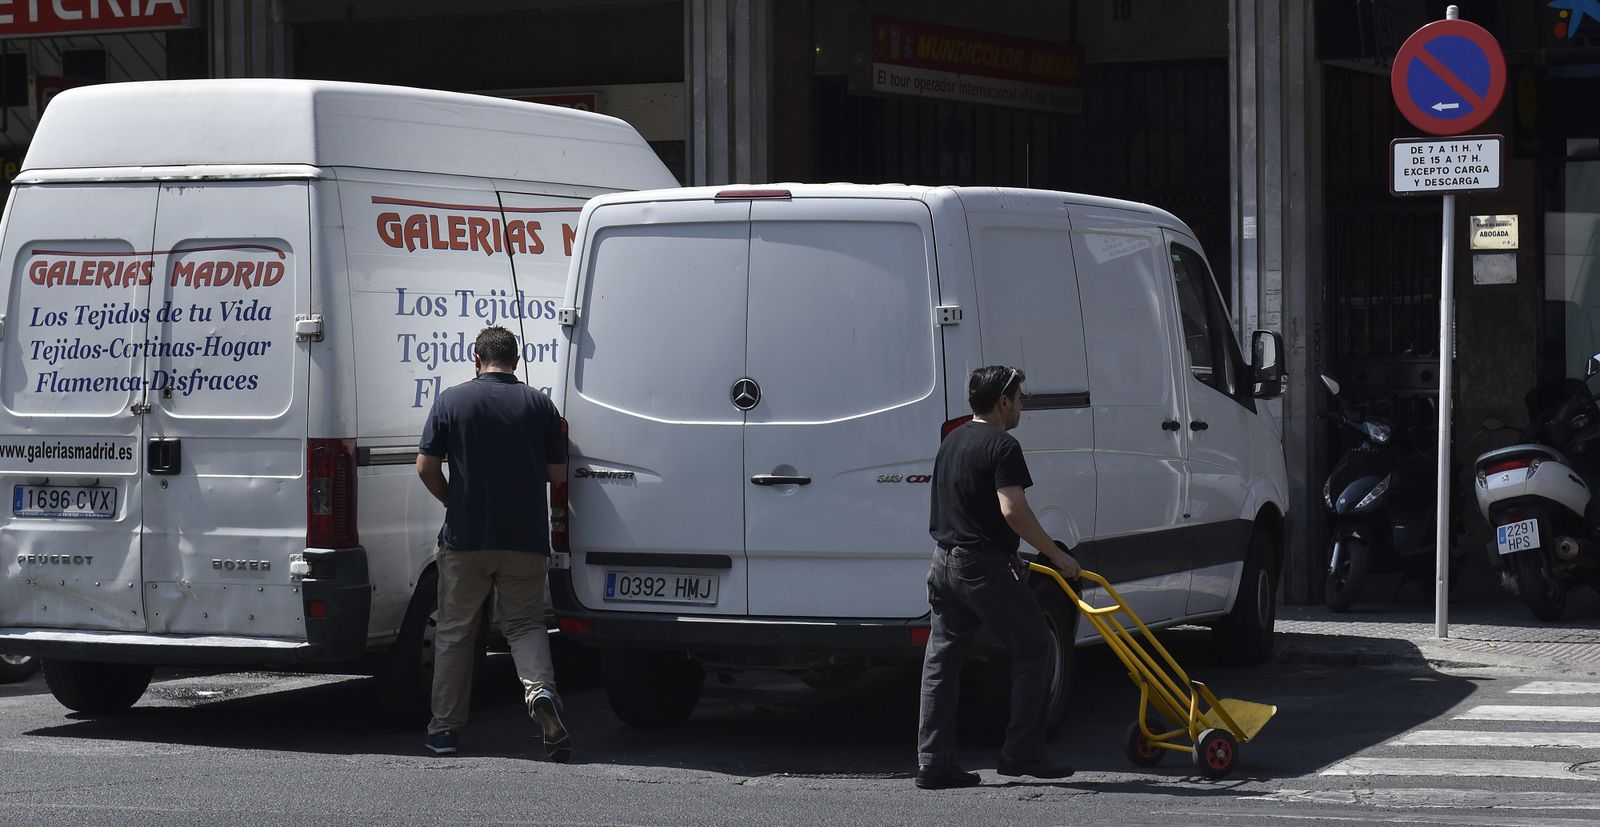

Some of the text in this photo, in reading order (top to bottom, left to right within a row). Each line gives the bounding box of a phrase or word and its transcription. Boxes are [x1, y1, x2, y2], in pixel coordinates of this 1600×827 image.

[1112, 0, 1132, 21] 10
[916, 33, 1025, 70] MUNDICOLOR
[877, 70, 887, 85] El
[890, 73, 911, 88] tour
[914, 77, 957, 95] operador
[960, 79, 1017, 102] internacional
[1410, 146, 1423, 154] DE
[1439, 145, 1446, 153] A
[1450, 145, 1458, 153] 11
[1462, 144, 1472, 152] H.
[1476, 143, 1483, 151] Y
[1412, 157, 1425, 165] DE
[1430, 156, 1440, 164] 15
[1457, 155, 1467, 163] 17
[1471, 154, 1482, 162] H.
[1404, 165, 1490, 176] EXCEPTO CARGA
[1414, 176, 1480, 187] Y DESCARGA
[377, 212, 545, 257] GALERIAS
[1479, 230, 1509, 238] ABOGADA
[29, 260, 285, 290] GALERIAS MADRID
[29, 299, 272, 331] Los Tejidos de tu Vida
[395, 287, 556, 326] Los Tejidos
[35, 368, 258, 397] Flamenca-Disfraces
[28, 489, 111, 511] 1696 CVX
[1507, 521, 1534, 537] 2291
[1509, 535, 1531, 550] HPS
[17, 553, 94, 565] PEUGEOT
[211, 558, 271, 571] BOXER
[620, 576, 712, 598] 0392 HMJ
